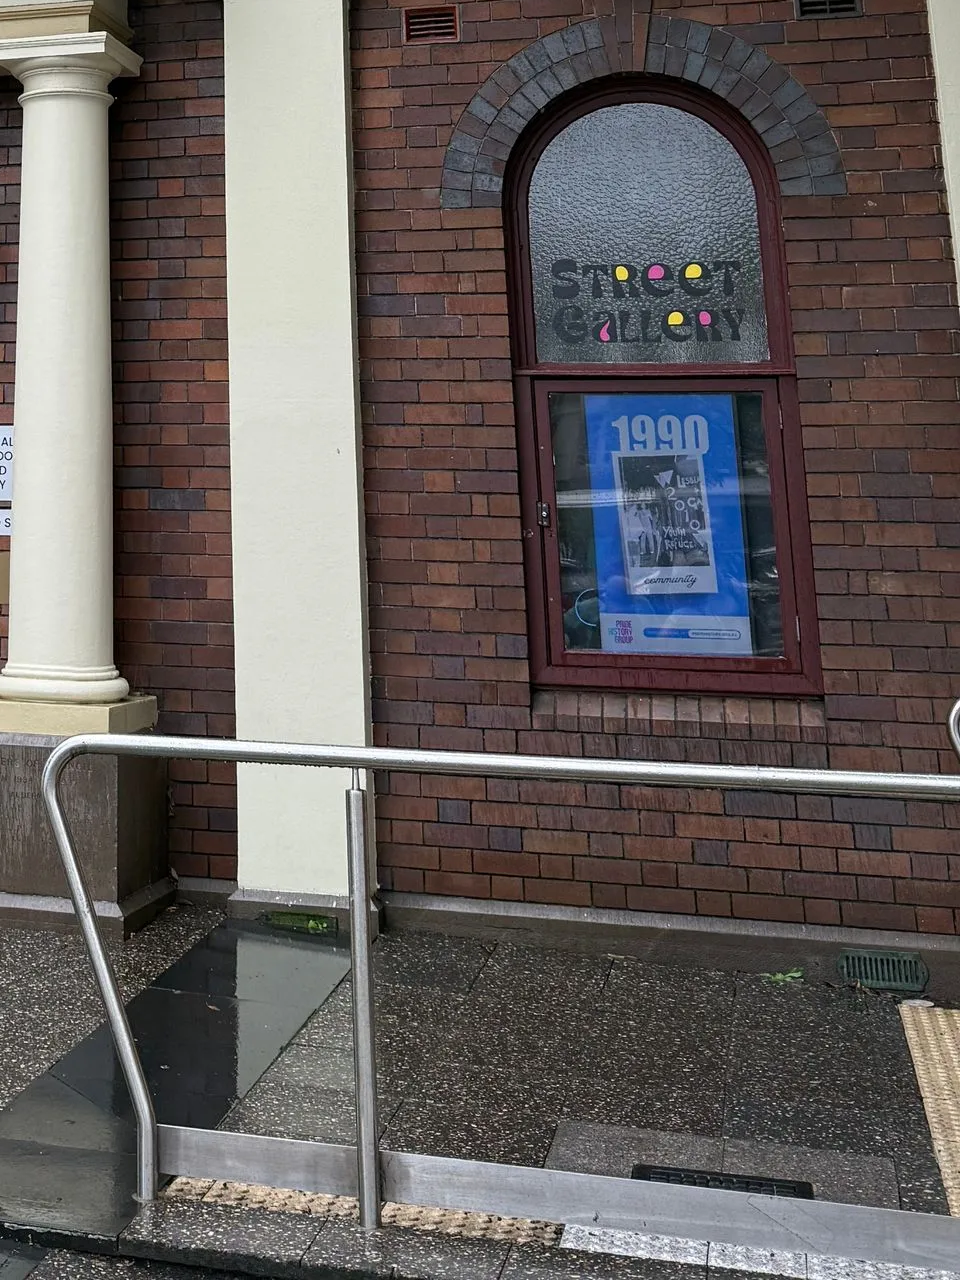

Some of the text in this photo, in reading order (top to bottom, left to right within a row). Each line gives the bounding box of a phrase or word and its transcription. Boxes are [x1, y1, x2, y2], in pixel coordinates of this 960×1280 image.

[612, 415, 709, 453] 1990
[4, 517, 11, 528] S
[644, 575, 697, 588] community
